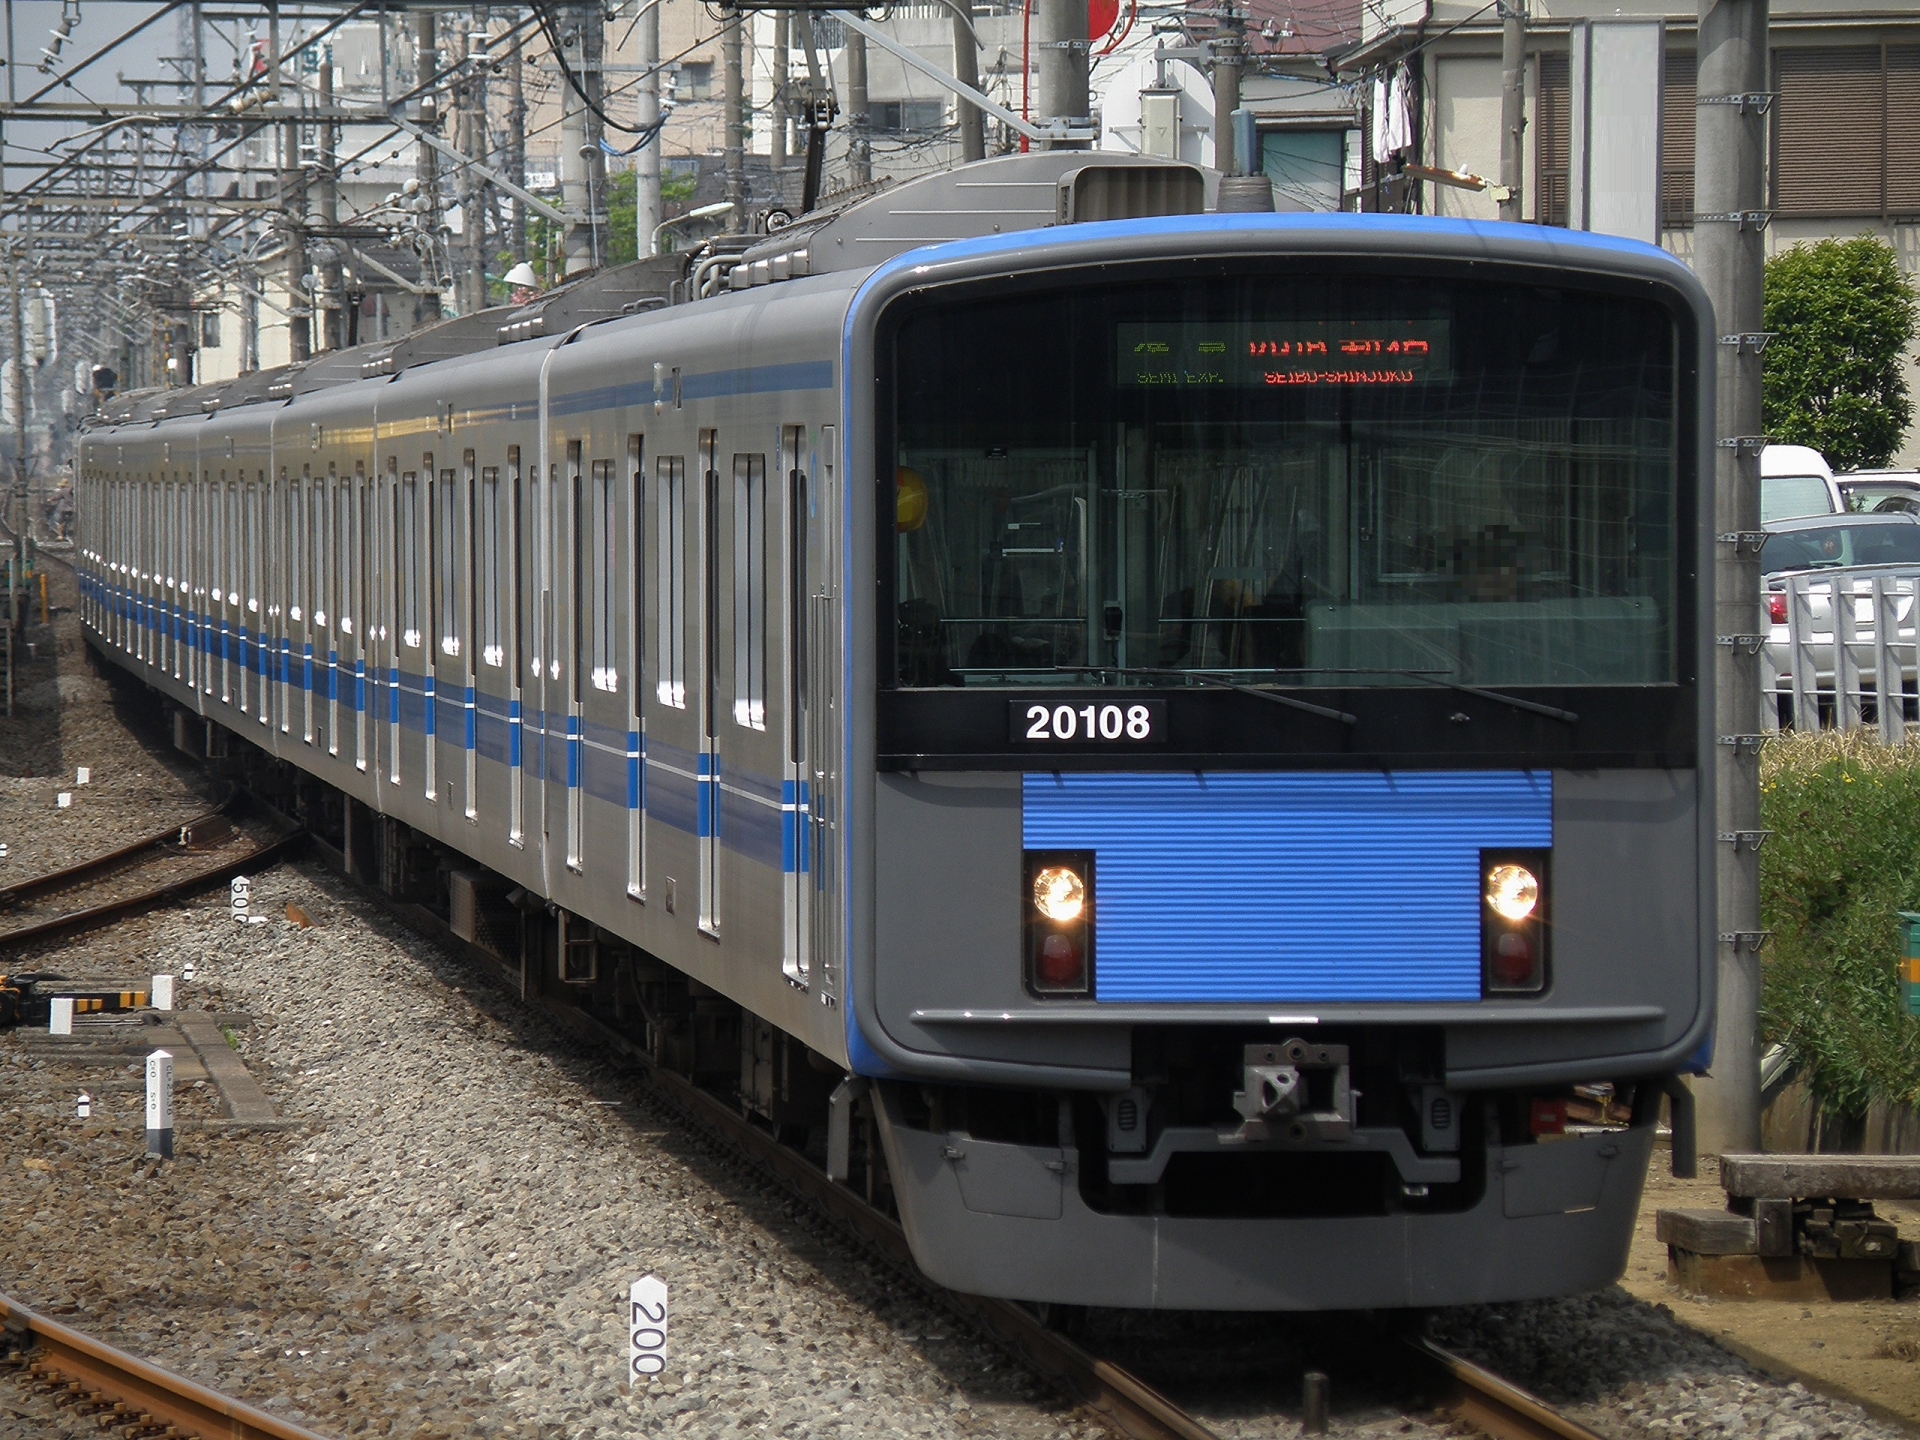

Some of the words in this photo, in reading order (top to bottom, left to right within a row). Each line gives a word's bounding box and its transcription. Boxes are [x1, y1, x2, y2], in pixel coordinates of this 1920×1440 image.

[1026, 704, 1151, 740] 20108
[232, 883, 249, 924] 500
[631, 1301, 666, 1376] 200
